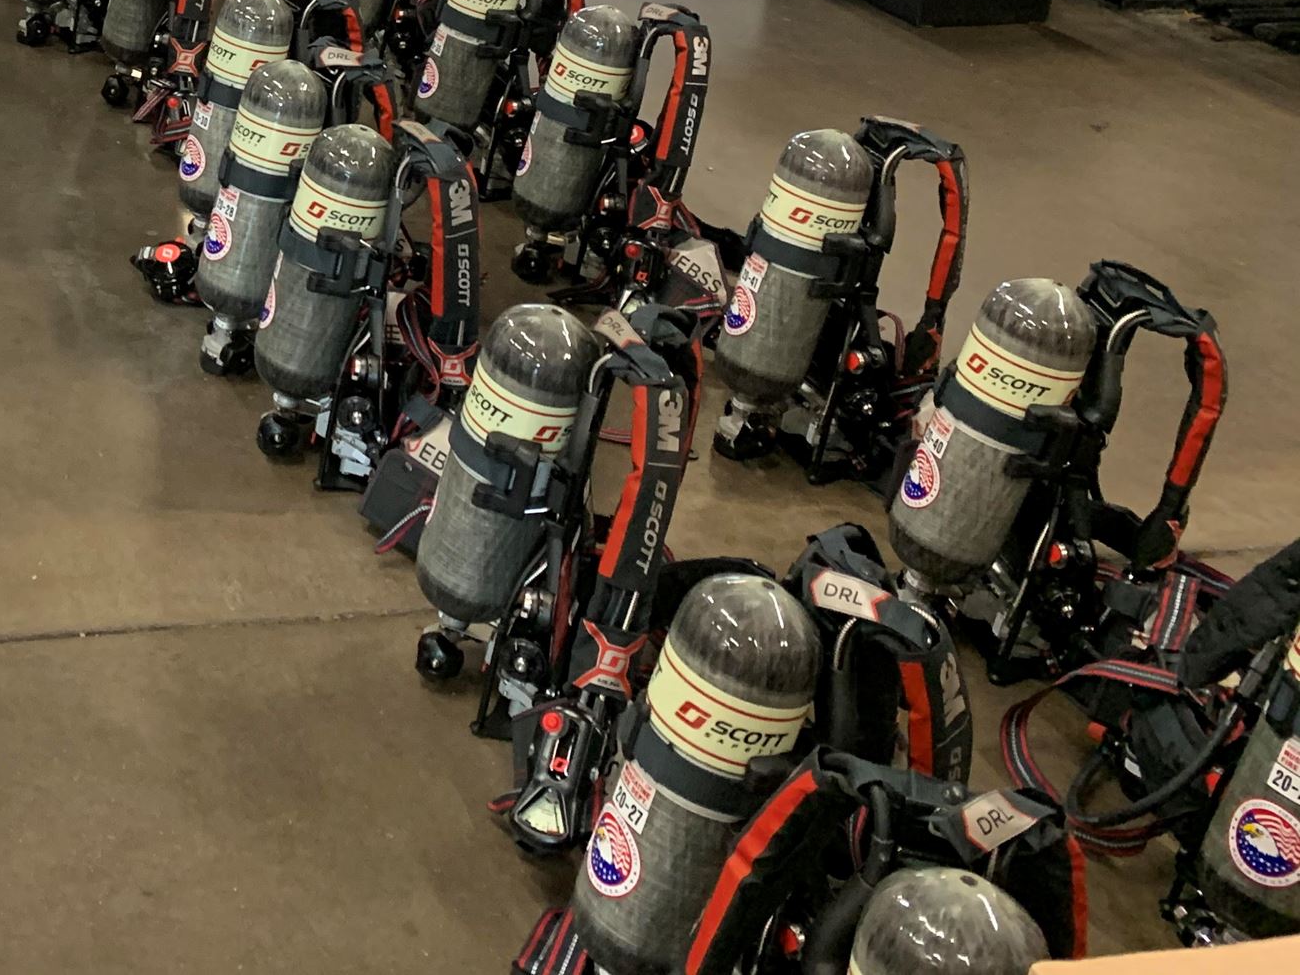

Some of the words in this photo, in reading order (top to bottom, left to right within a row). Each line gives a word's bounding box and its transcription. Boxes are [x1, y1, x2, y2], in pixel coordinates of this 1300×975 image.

[210, 41, 237, 61] SCOTT
[326, 50, 352, 61] DRL
[691, 35, 708, 76] 3M
[566, 68, 610, 90] SCOTT
[235, 121, 266, 144] SCOTT
[680, 108, 698, 157] SCOTT
[327, 208, 376, 228] SCOTT
[449, 179, 473, 226] 3M
[813, 214, 858, 231] SCOTT
[457, 263, 470, 306] SCOTT
[602, 315, 625, 337] DRL
[988, 366, 1052, 399] SCOTT
[471, 384, 513, 423] SCOTT
[657, 390, 683, 452] 3M
[636, 502, 664, 575] SCOTT
[824, 582, 863, 606] DRL
[939, 652, 966, 728] 3M
[711, 720, 789, 748] SCOTT
[615, 786, 643, 826] 20-27
[977, 807, 1015, 836] DRL
